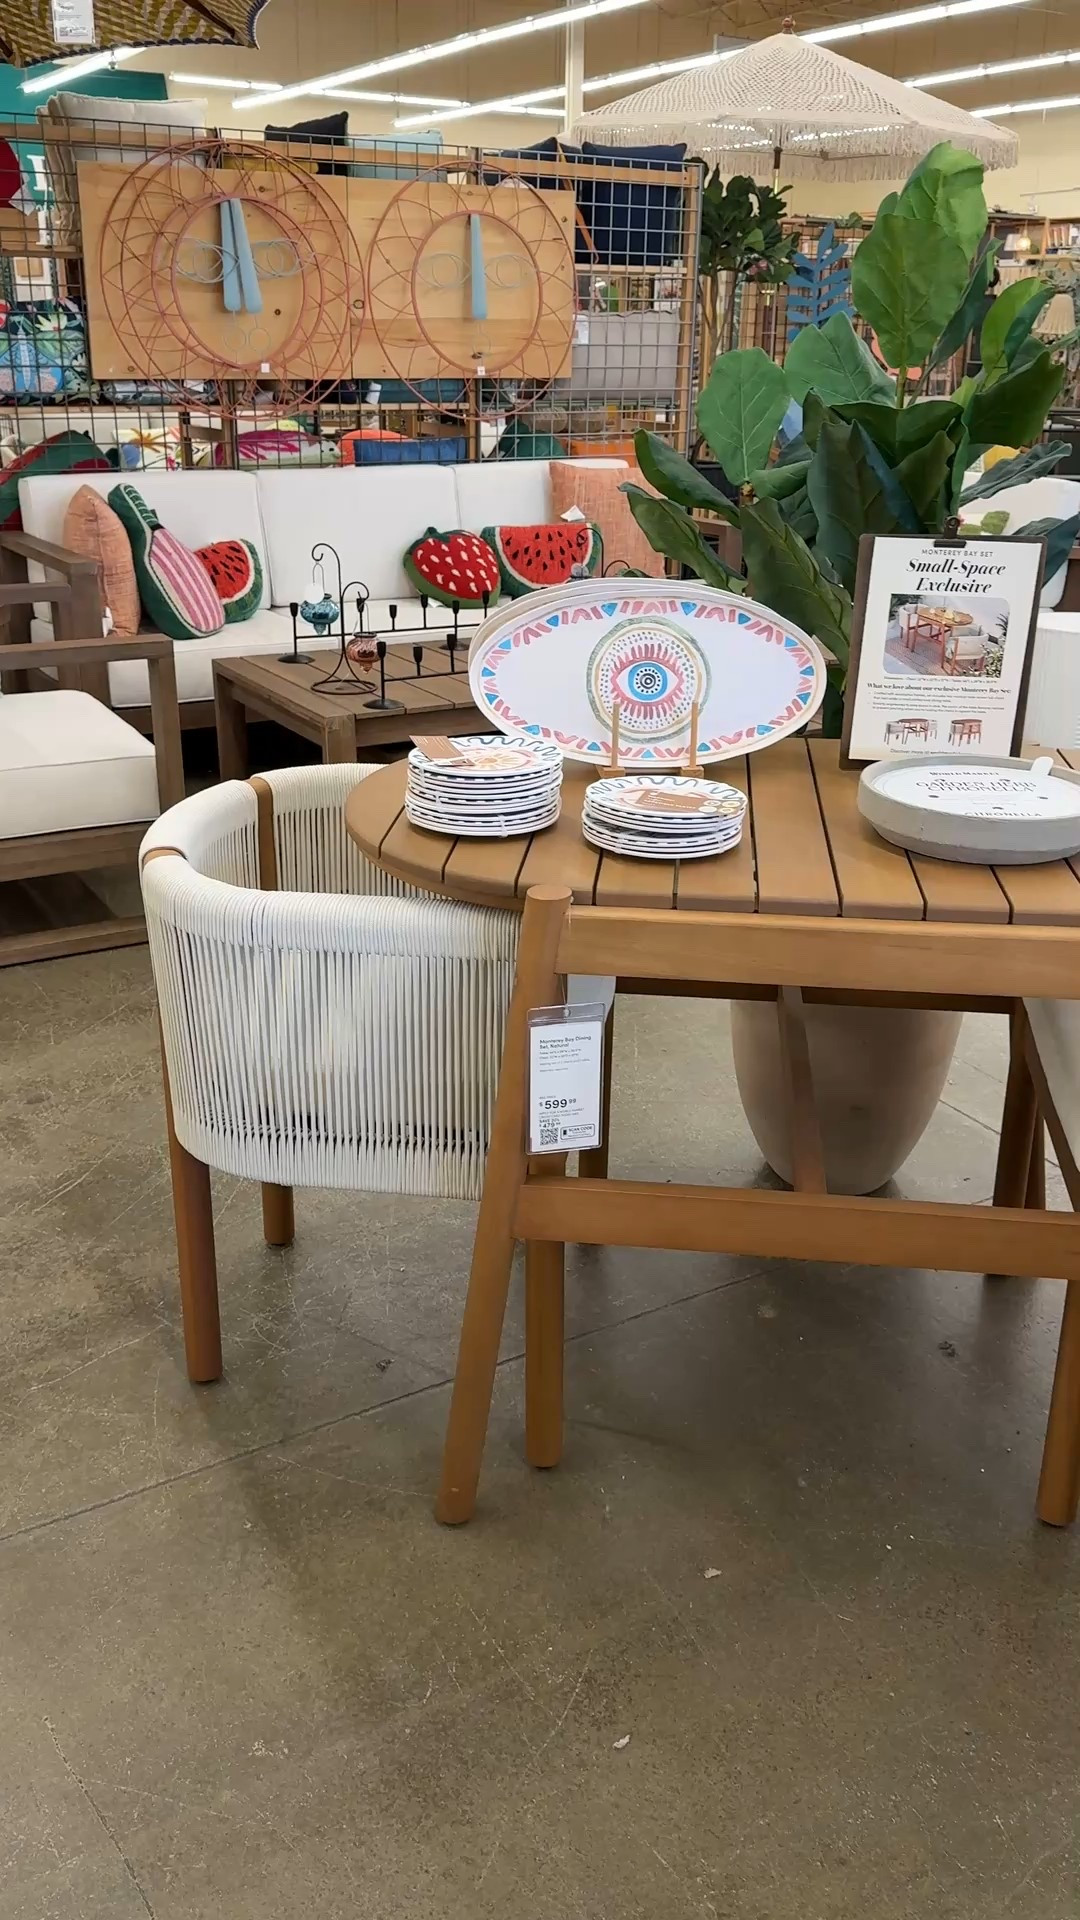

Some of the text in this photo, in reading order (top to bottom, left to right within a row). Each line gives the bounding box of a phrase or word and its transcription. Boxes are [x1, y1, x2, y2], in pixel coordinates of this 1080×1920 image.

[906, 558, 1006, 578] Small-Space
[916, 577, 992, 593] Exclusive
[544, 1098, 568, 1110] 599
